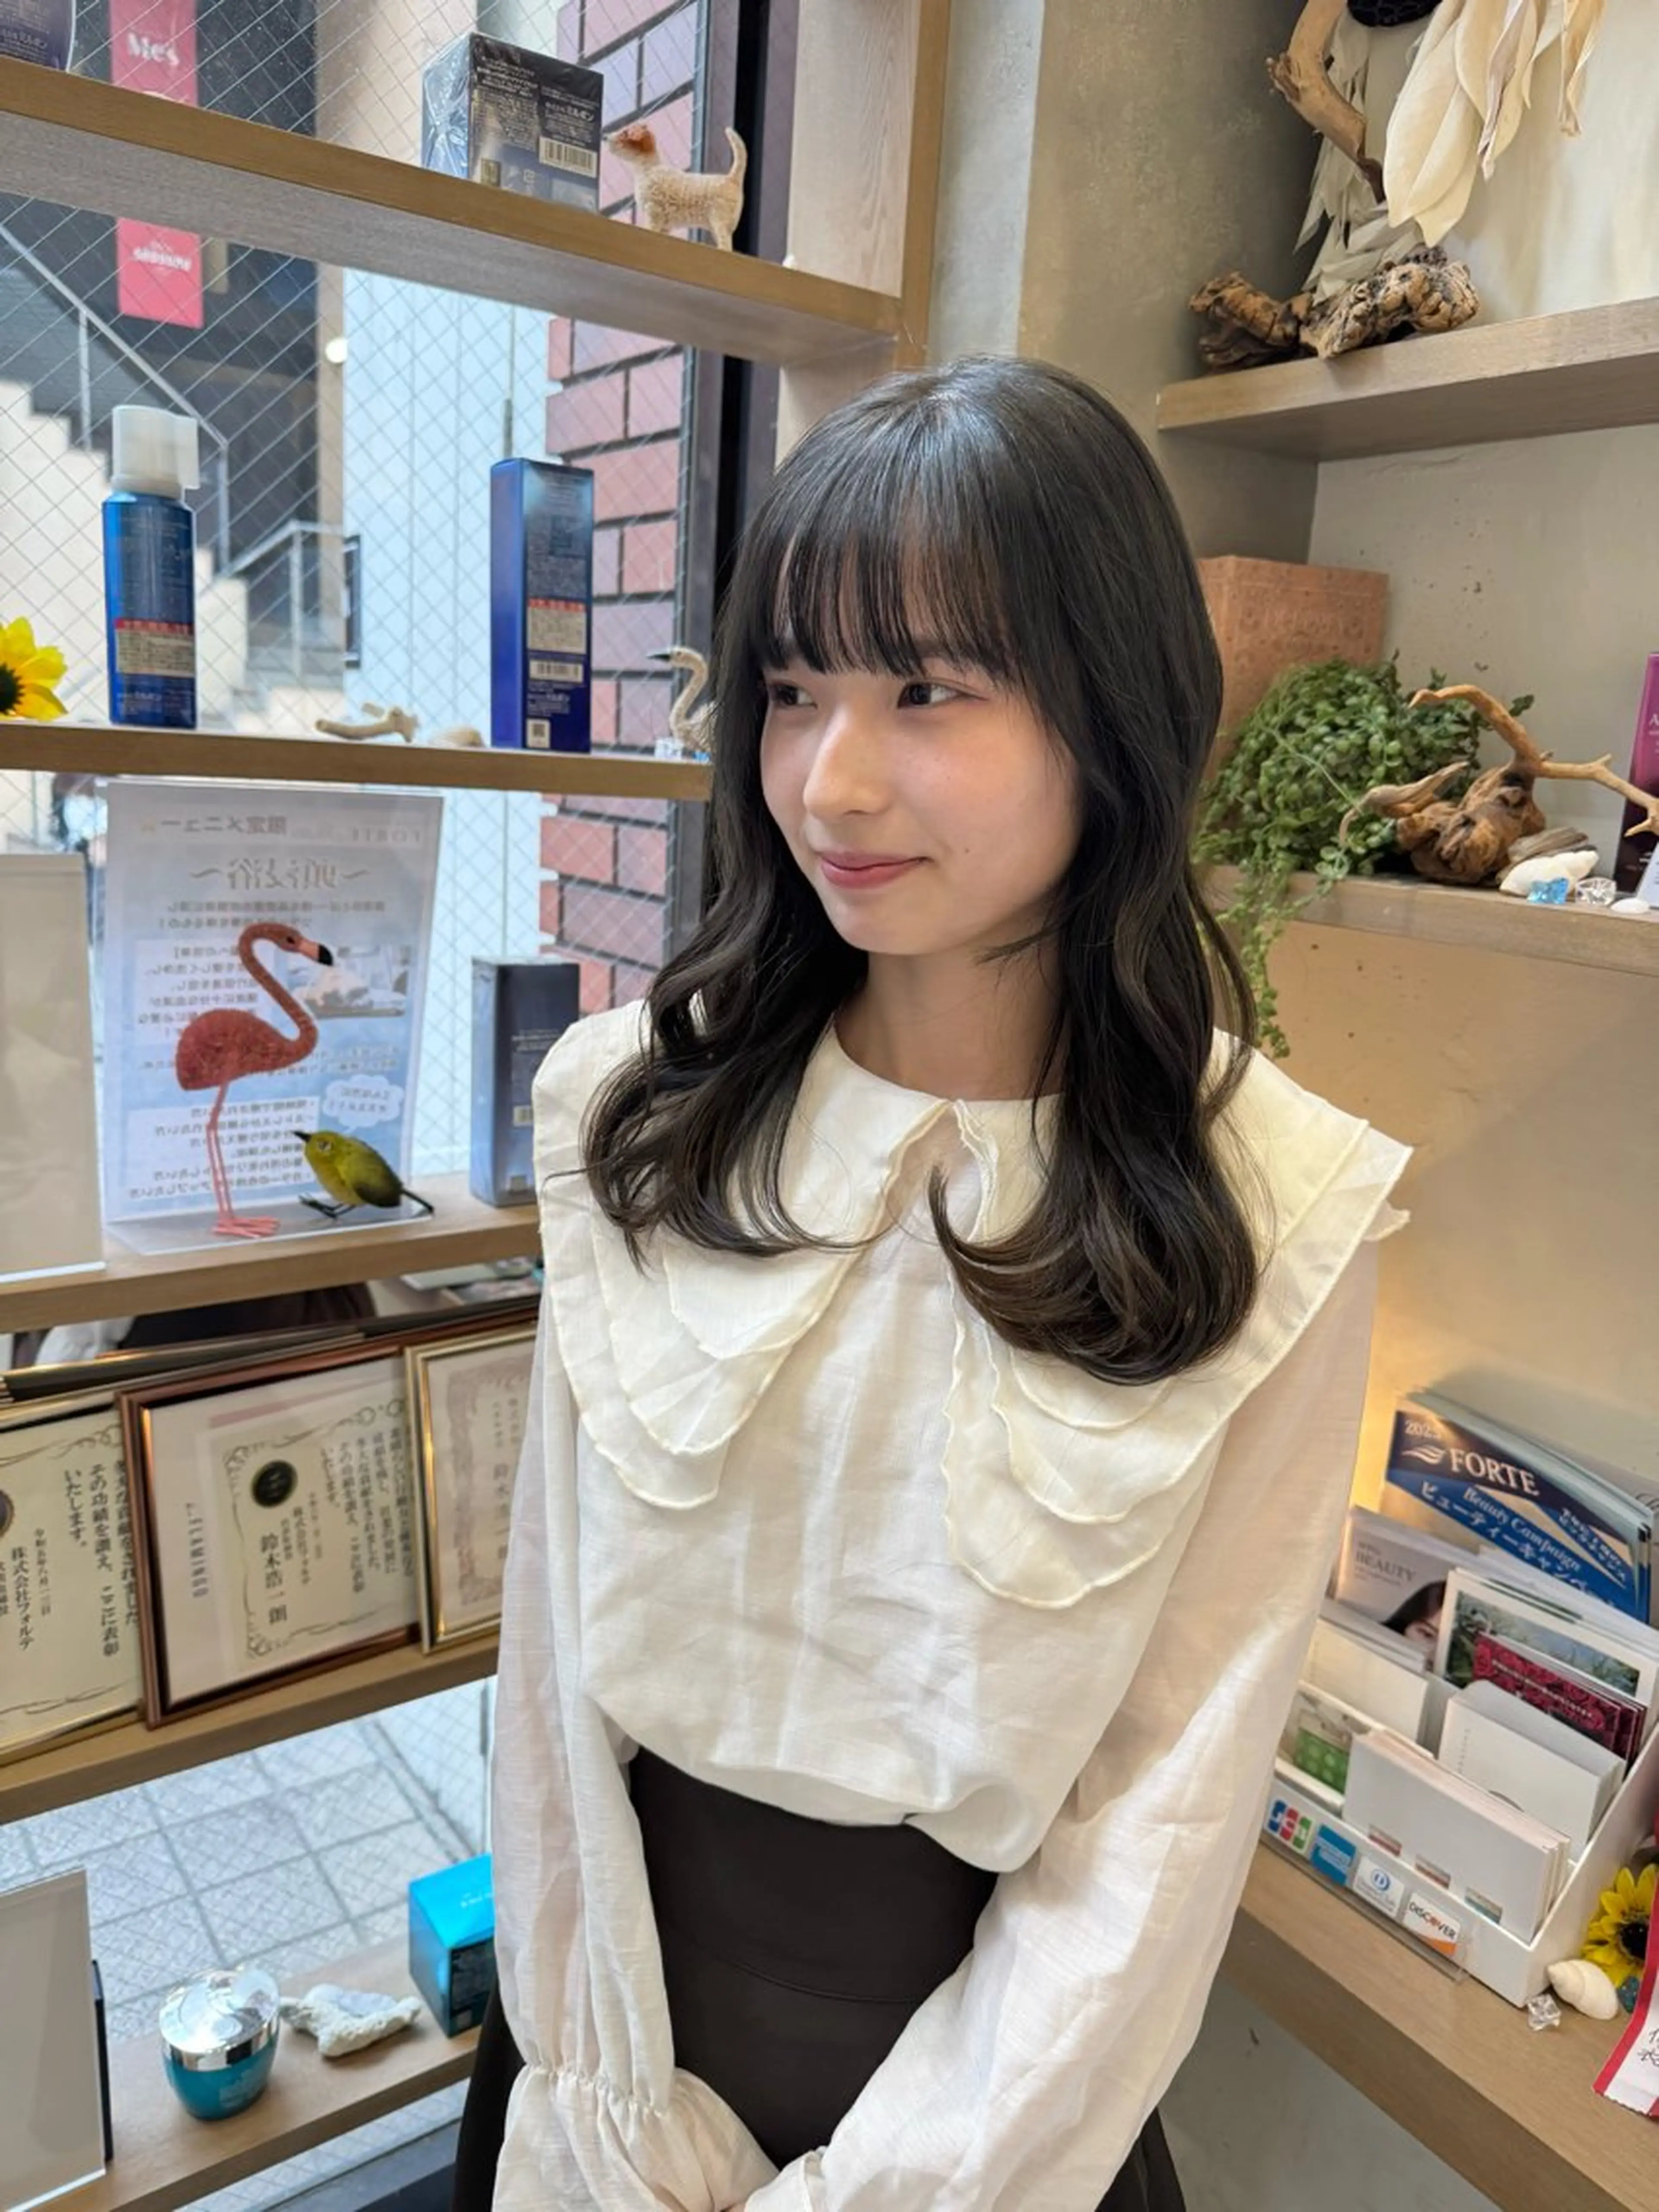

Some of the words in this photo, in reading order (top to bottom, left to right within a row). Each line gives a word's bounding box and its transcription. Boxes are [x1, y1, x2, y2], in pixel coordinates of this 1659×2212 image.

[1449, 1448, 1540, 1496] FORTE
[1463, 1486, 1510, 1526] Beauty
[1511, 1517, 1582, 1572] Campaign
[1267, 1799, 1312, 1850] JCB
[1409, 1901, 1457, 1939] DISCOVER
